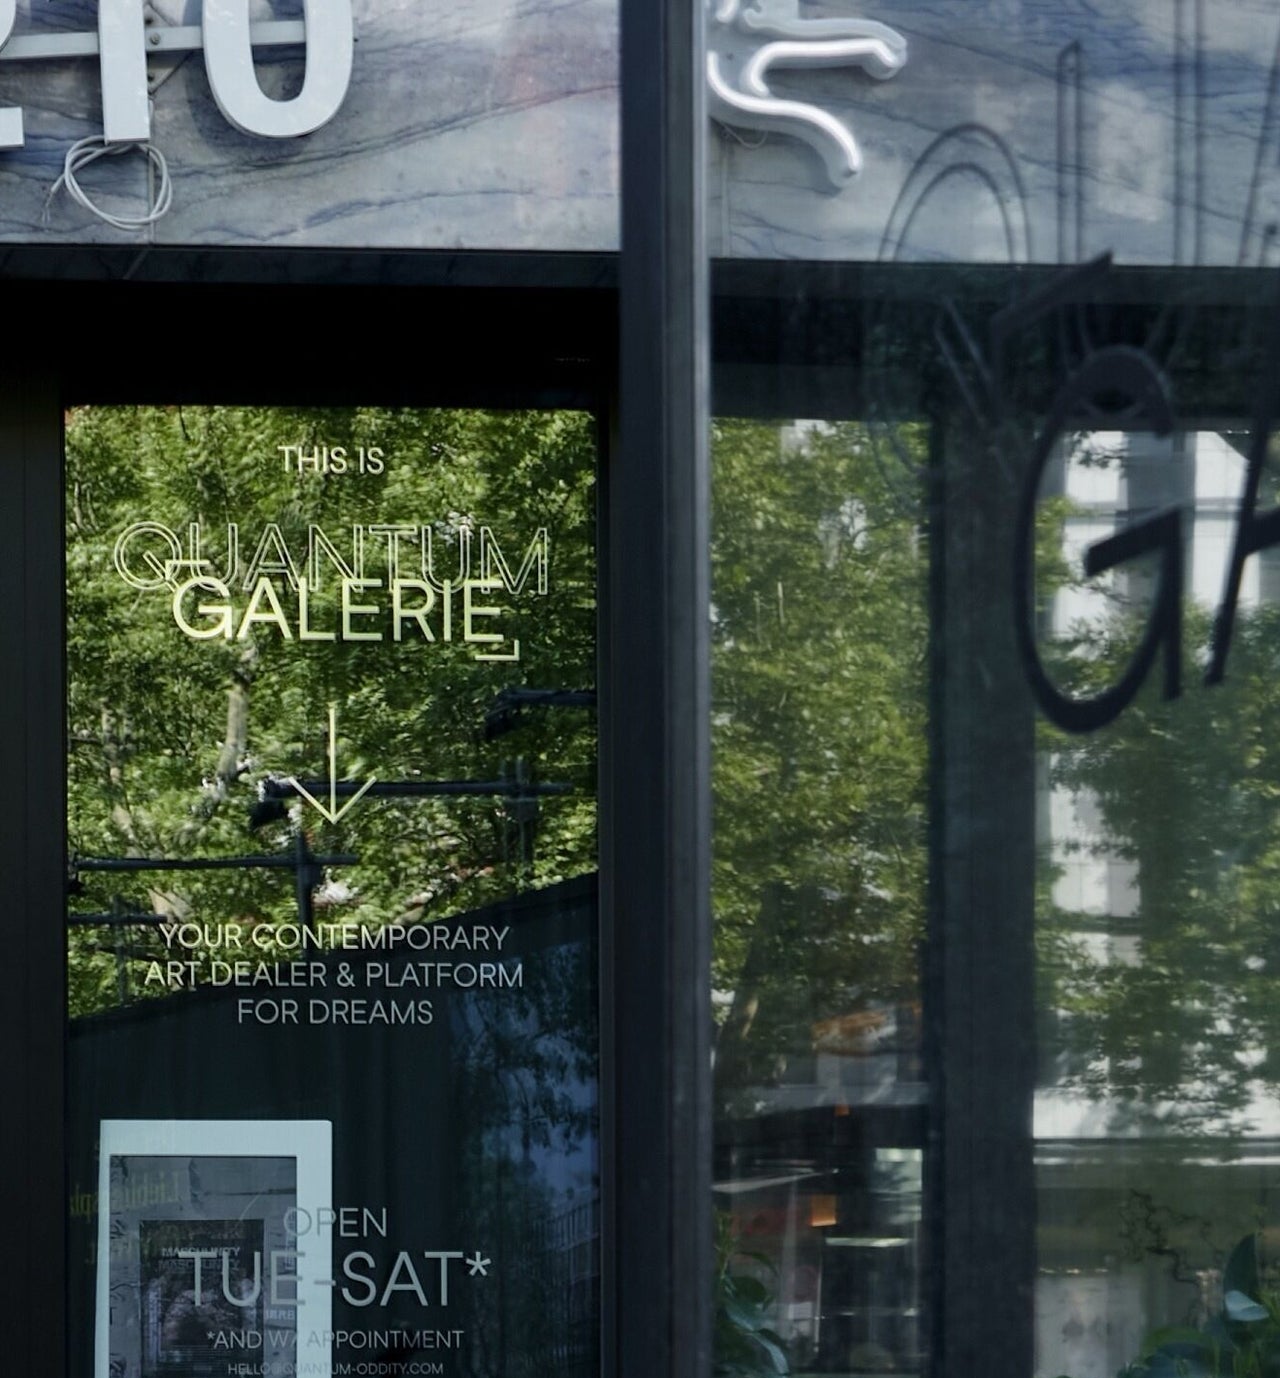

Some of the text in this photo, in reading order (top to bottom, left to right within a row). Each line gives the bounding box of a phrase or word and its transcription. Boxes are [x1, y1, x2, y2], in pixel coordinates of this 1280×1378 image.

[277, 445, 385, 475] THIS IS
[113, 520, 549, 596] QUANTUM
[171, 576, 506, 644] GALERIE
[159, 923, 510, 952] YOUR CONTEMPORARY
[144, 960, 524, 989] ART DEALER & PLATFORM
[237, 999, 434, 1027] FOR DREAMS
[283, 1206, 387, 1238] OPEN
[306, 1330, 465, 1350] APPOINTMENT
